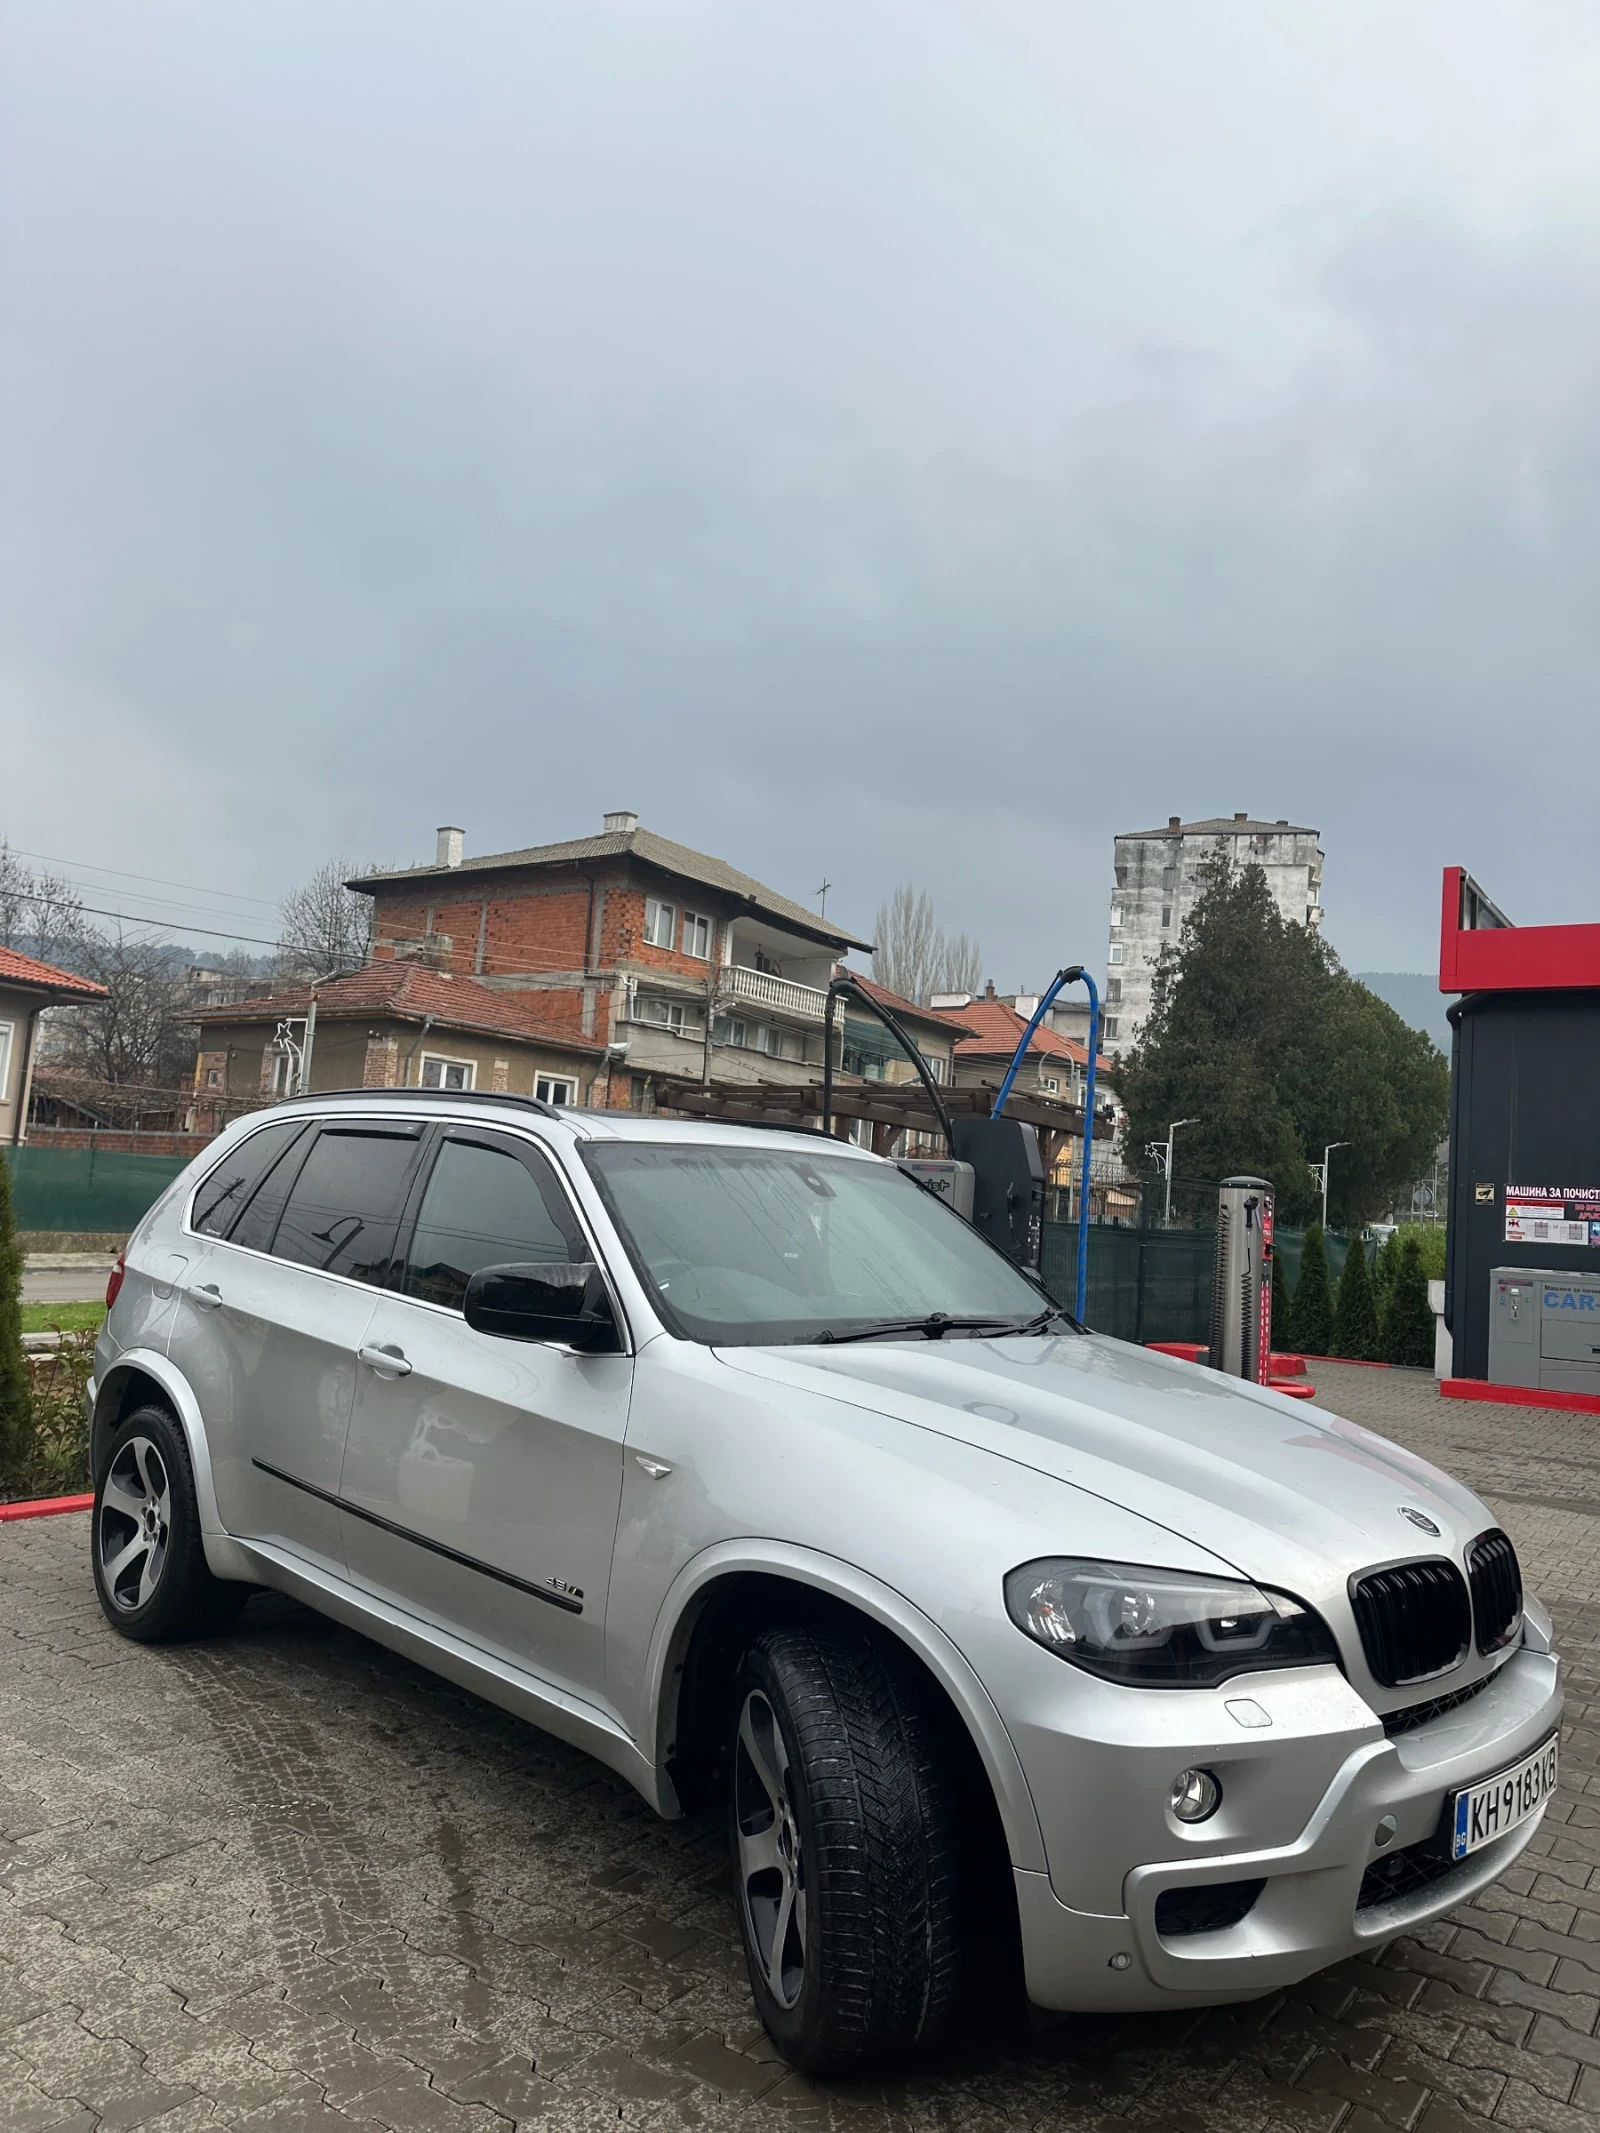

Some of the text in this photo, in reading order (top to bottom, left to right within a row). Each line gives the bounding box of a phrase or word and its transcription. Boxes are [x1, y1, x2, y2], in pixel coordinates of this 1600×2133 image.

[1506, 1186, 1548, 1198] МАШИНА
[1549, 1187, 1562, 1198] ЗА
[1544, 1284, 1571, 1292] Машина
[1456, 1833, 1467, 1848] BG
